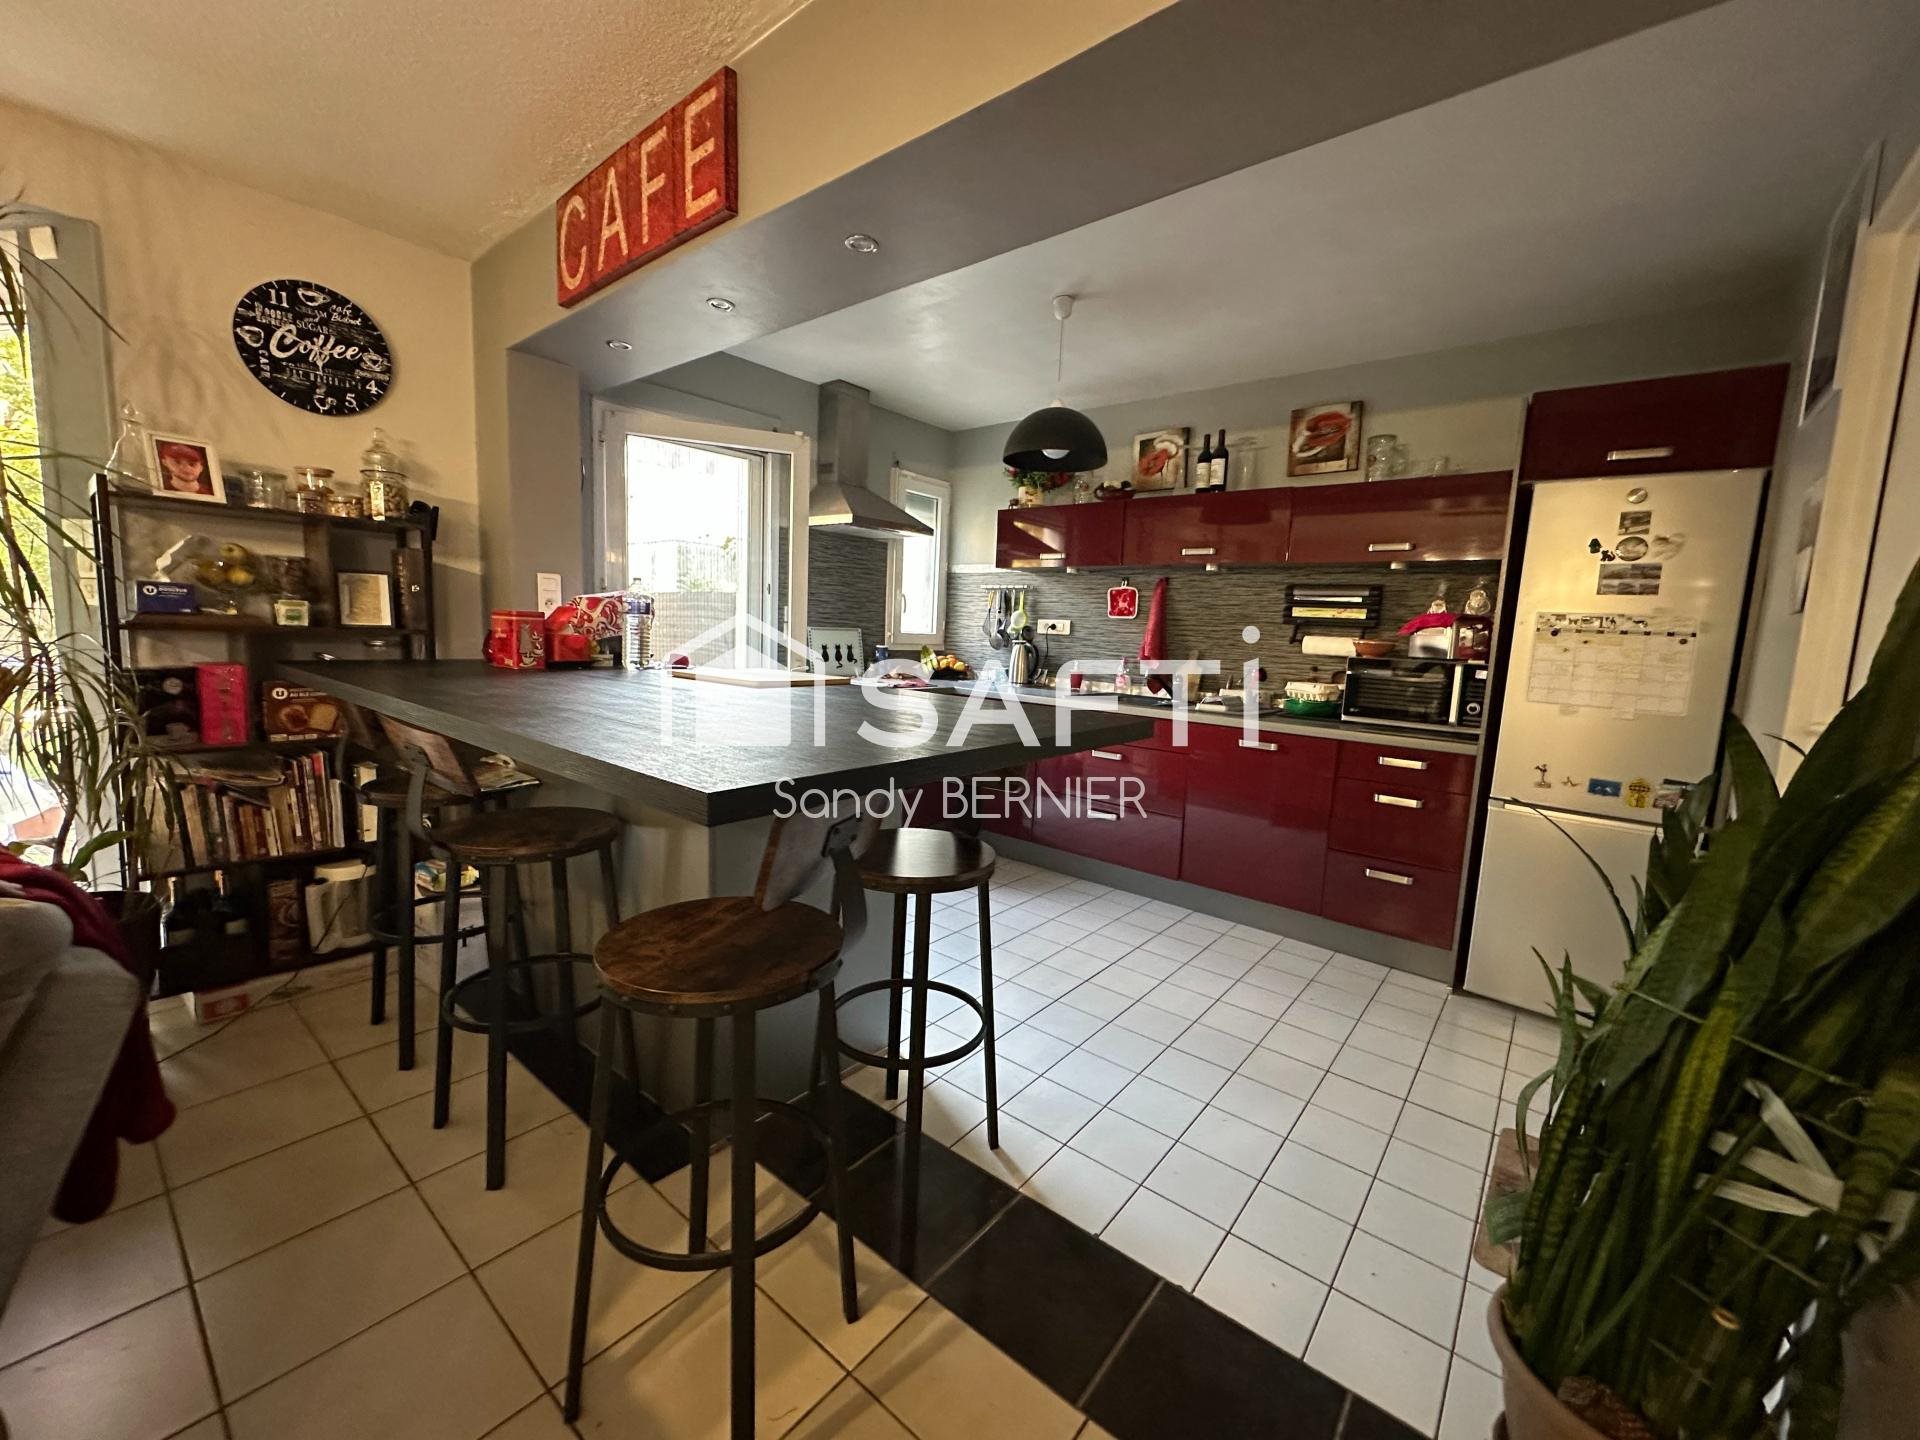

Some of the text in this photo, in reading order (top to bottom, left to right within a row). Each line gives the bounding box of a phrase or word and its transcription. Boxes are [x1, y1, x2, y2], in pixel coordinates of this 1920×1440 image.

[560, 87, 717, 290] CAFE
[268, 288, 290, 308] 11
[269, 324, 362, 363] Coffee
[366, 380, 378, 394] 4
[345, 393, 356, 407] 5
